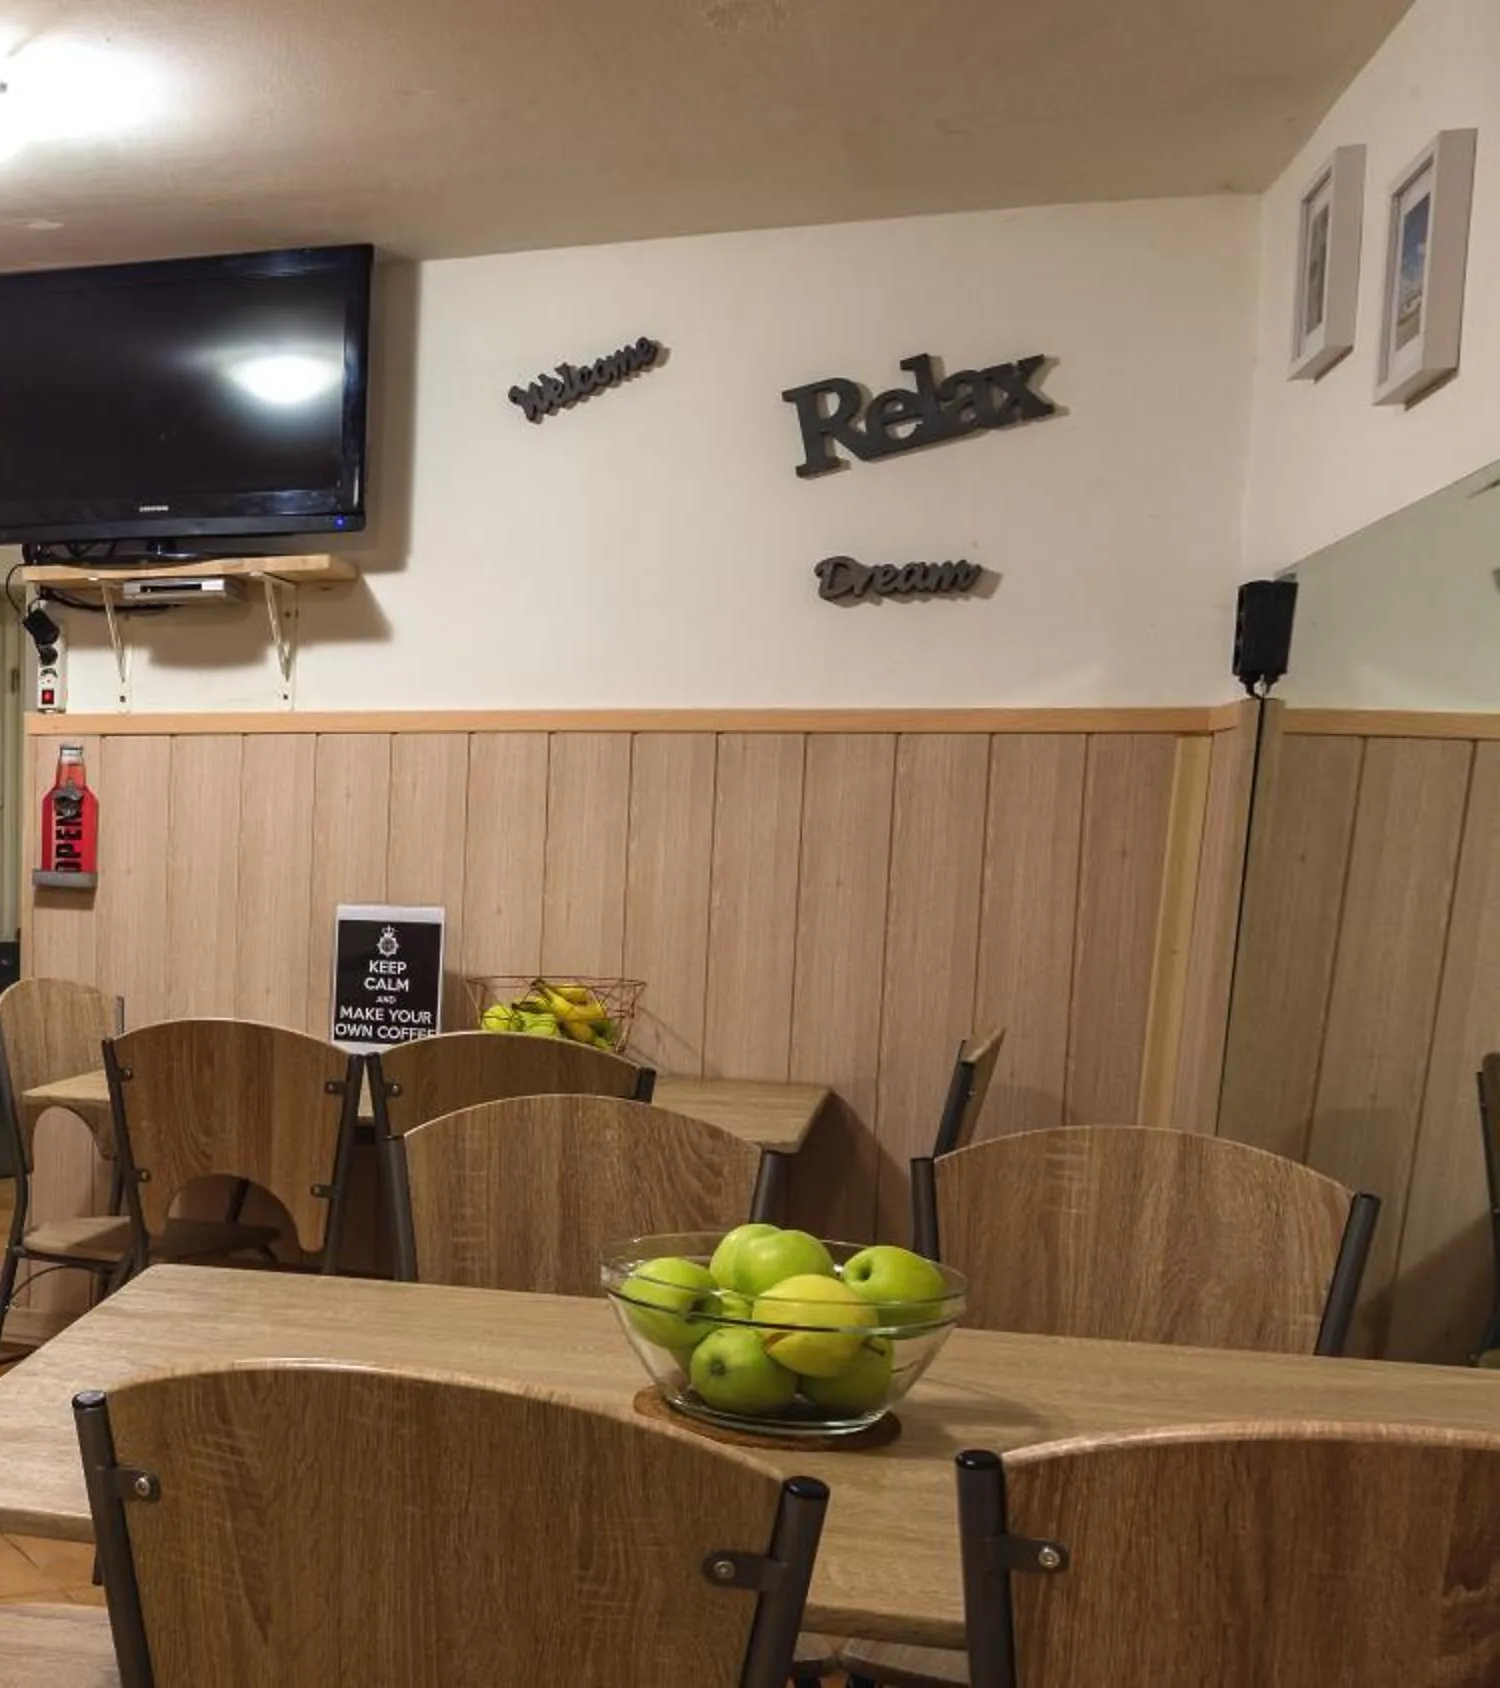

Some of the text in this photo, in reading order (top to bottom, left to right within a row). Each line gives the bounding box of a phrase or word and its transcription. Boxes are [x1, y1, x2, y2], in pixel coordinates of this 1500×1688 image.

[508, 337, 658, 423] Welcome
[781, 353, 1055, 478] Relax
[814, 556, 983, 600] Dream
[369, 960, 407, 974] KEEP
[364, 977, 409, 992] CALM
[376, 995, 397, 1004] AND
[340, 1006, 432, 1024] MAKE YOUR
[335, 1023, 373, 1038] OWN
